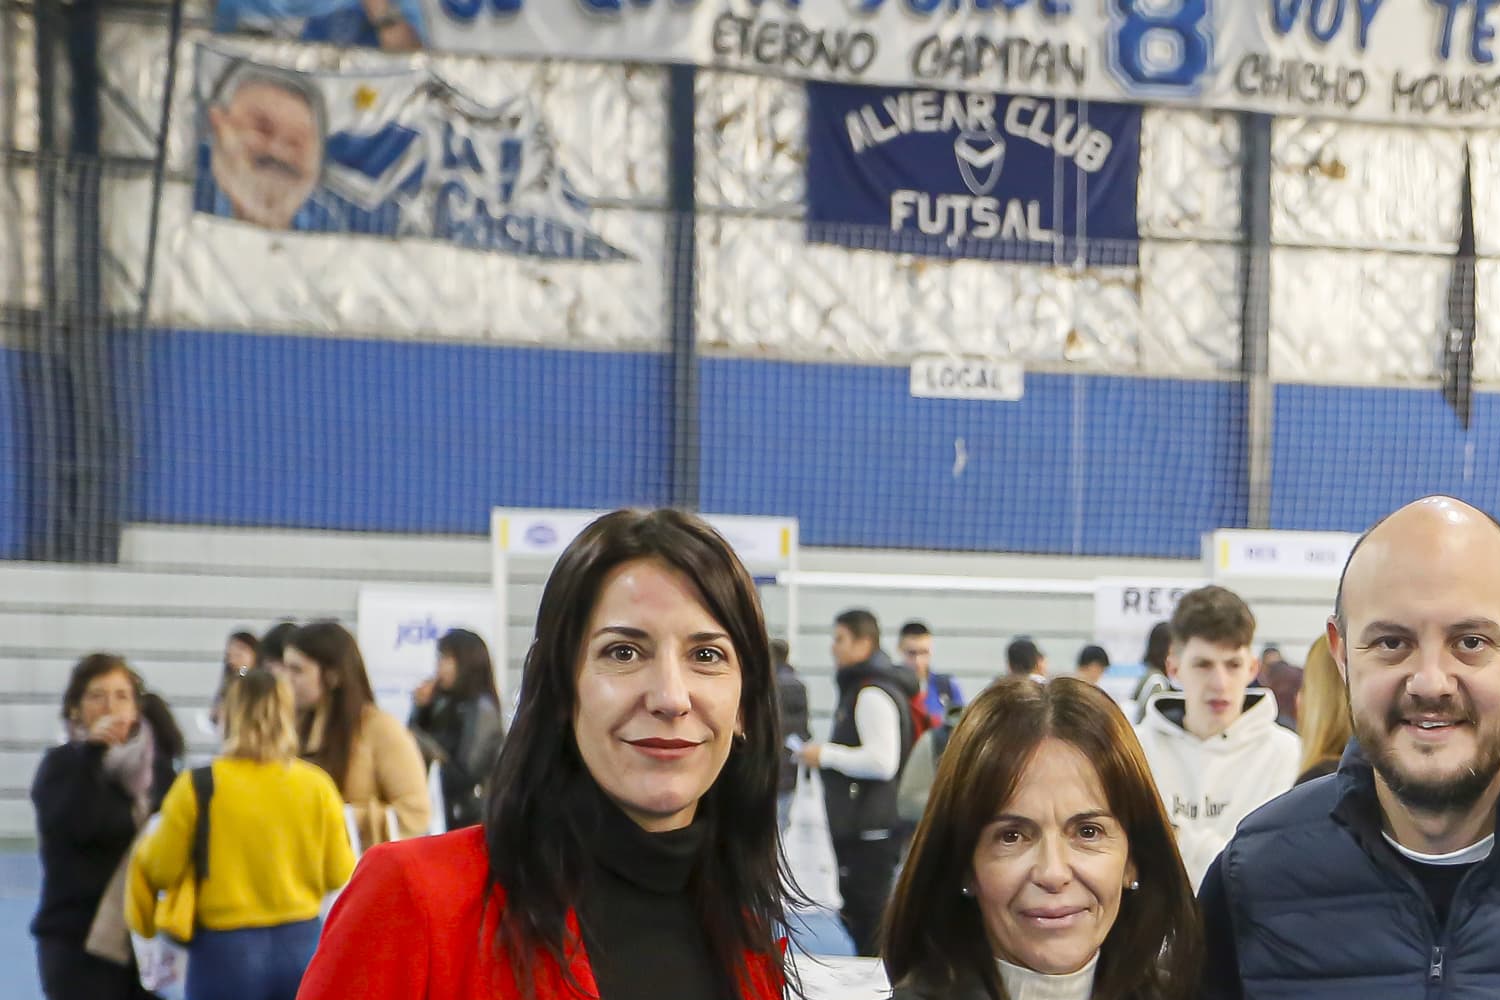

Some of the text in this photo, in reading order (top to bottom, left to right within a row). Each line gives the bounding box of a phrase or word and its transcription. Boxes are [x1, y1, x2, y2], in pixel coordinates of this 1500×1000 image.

[712, 12, 878, 74] ETERNO
[1100, 0, 1212, 97] 8
[845, 91, 1113, 173] ALVEAR CLUB
[890, 189, 1060, 246] FUTSAL
